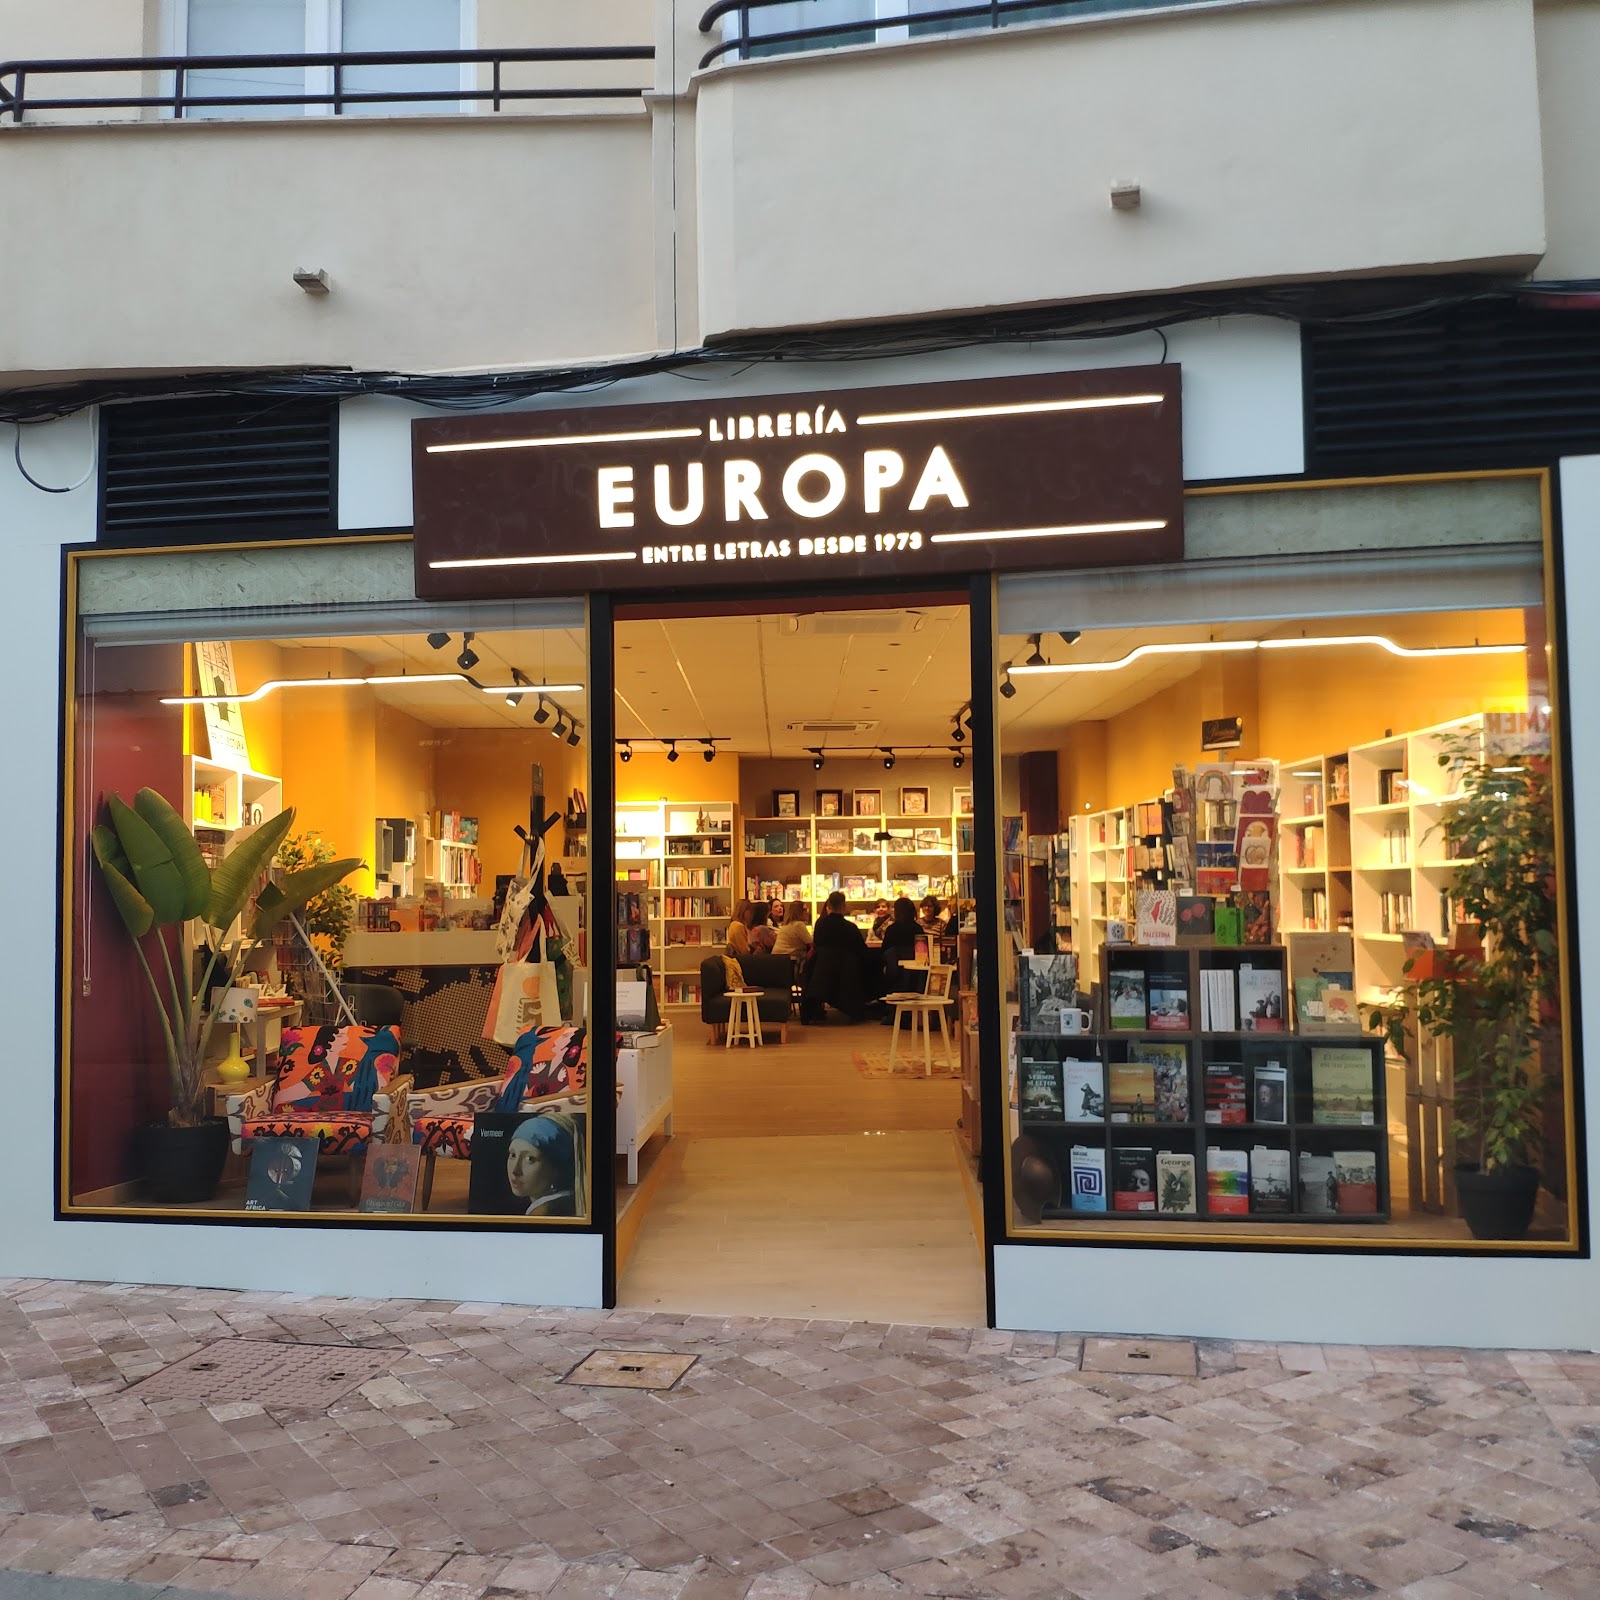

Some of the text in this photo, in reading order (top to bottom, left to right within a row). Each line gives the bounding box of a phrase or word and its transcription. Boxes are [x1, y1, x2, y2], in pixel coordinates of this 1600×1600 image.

[709, 404, 847, 442] LIBRERÍA
[597, 445, 970, 529] EUROPA
[641, 543, 707, 564] ENTRE
[713, 538, 791, 560] LETRAS
[798, 535, 867, 556] DESDE
[480, 1127, 505, 1138] Vermeer
[1160, 1158, 1192, 1168] George
